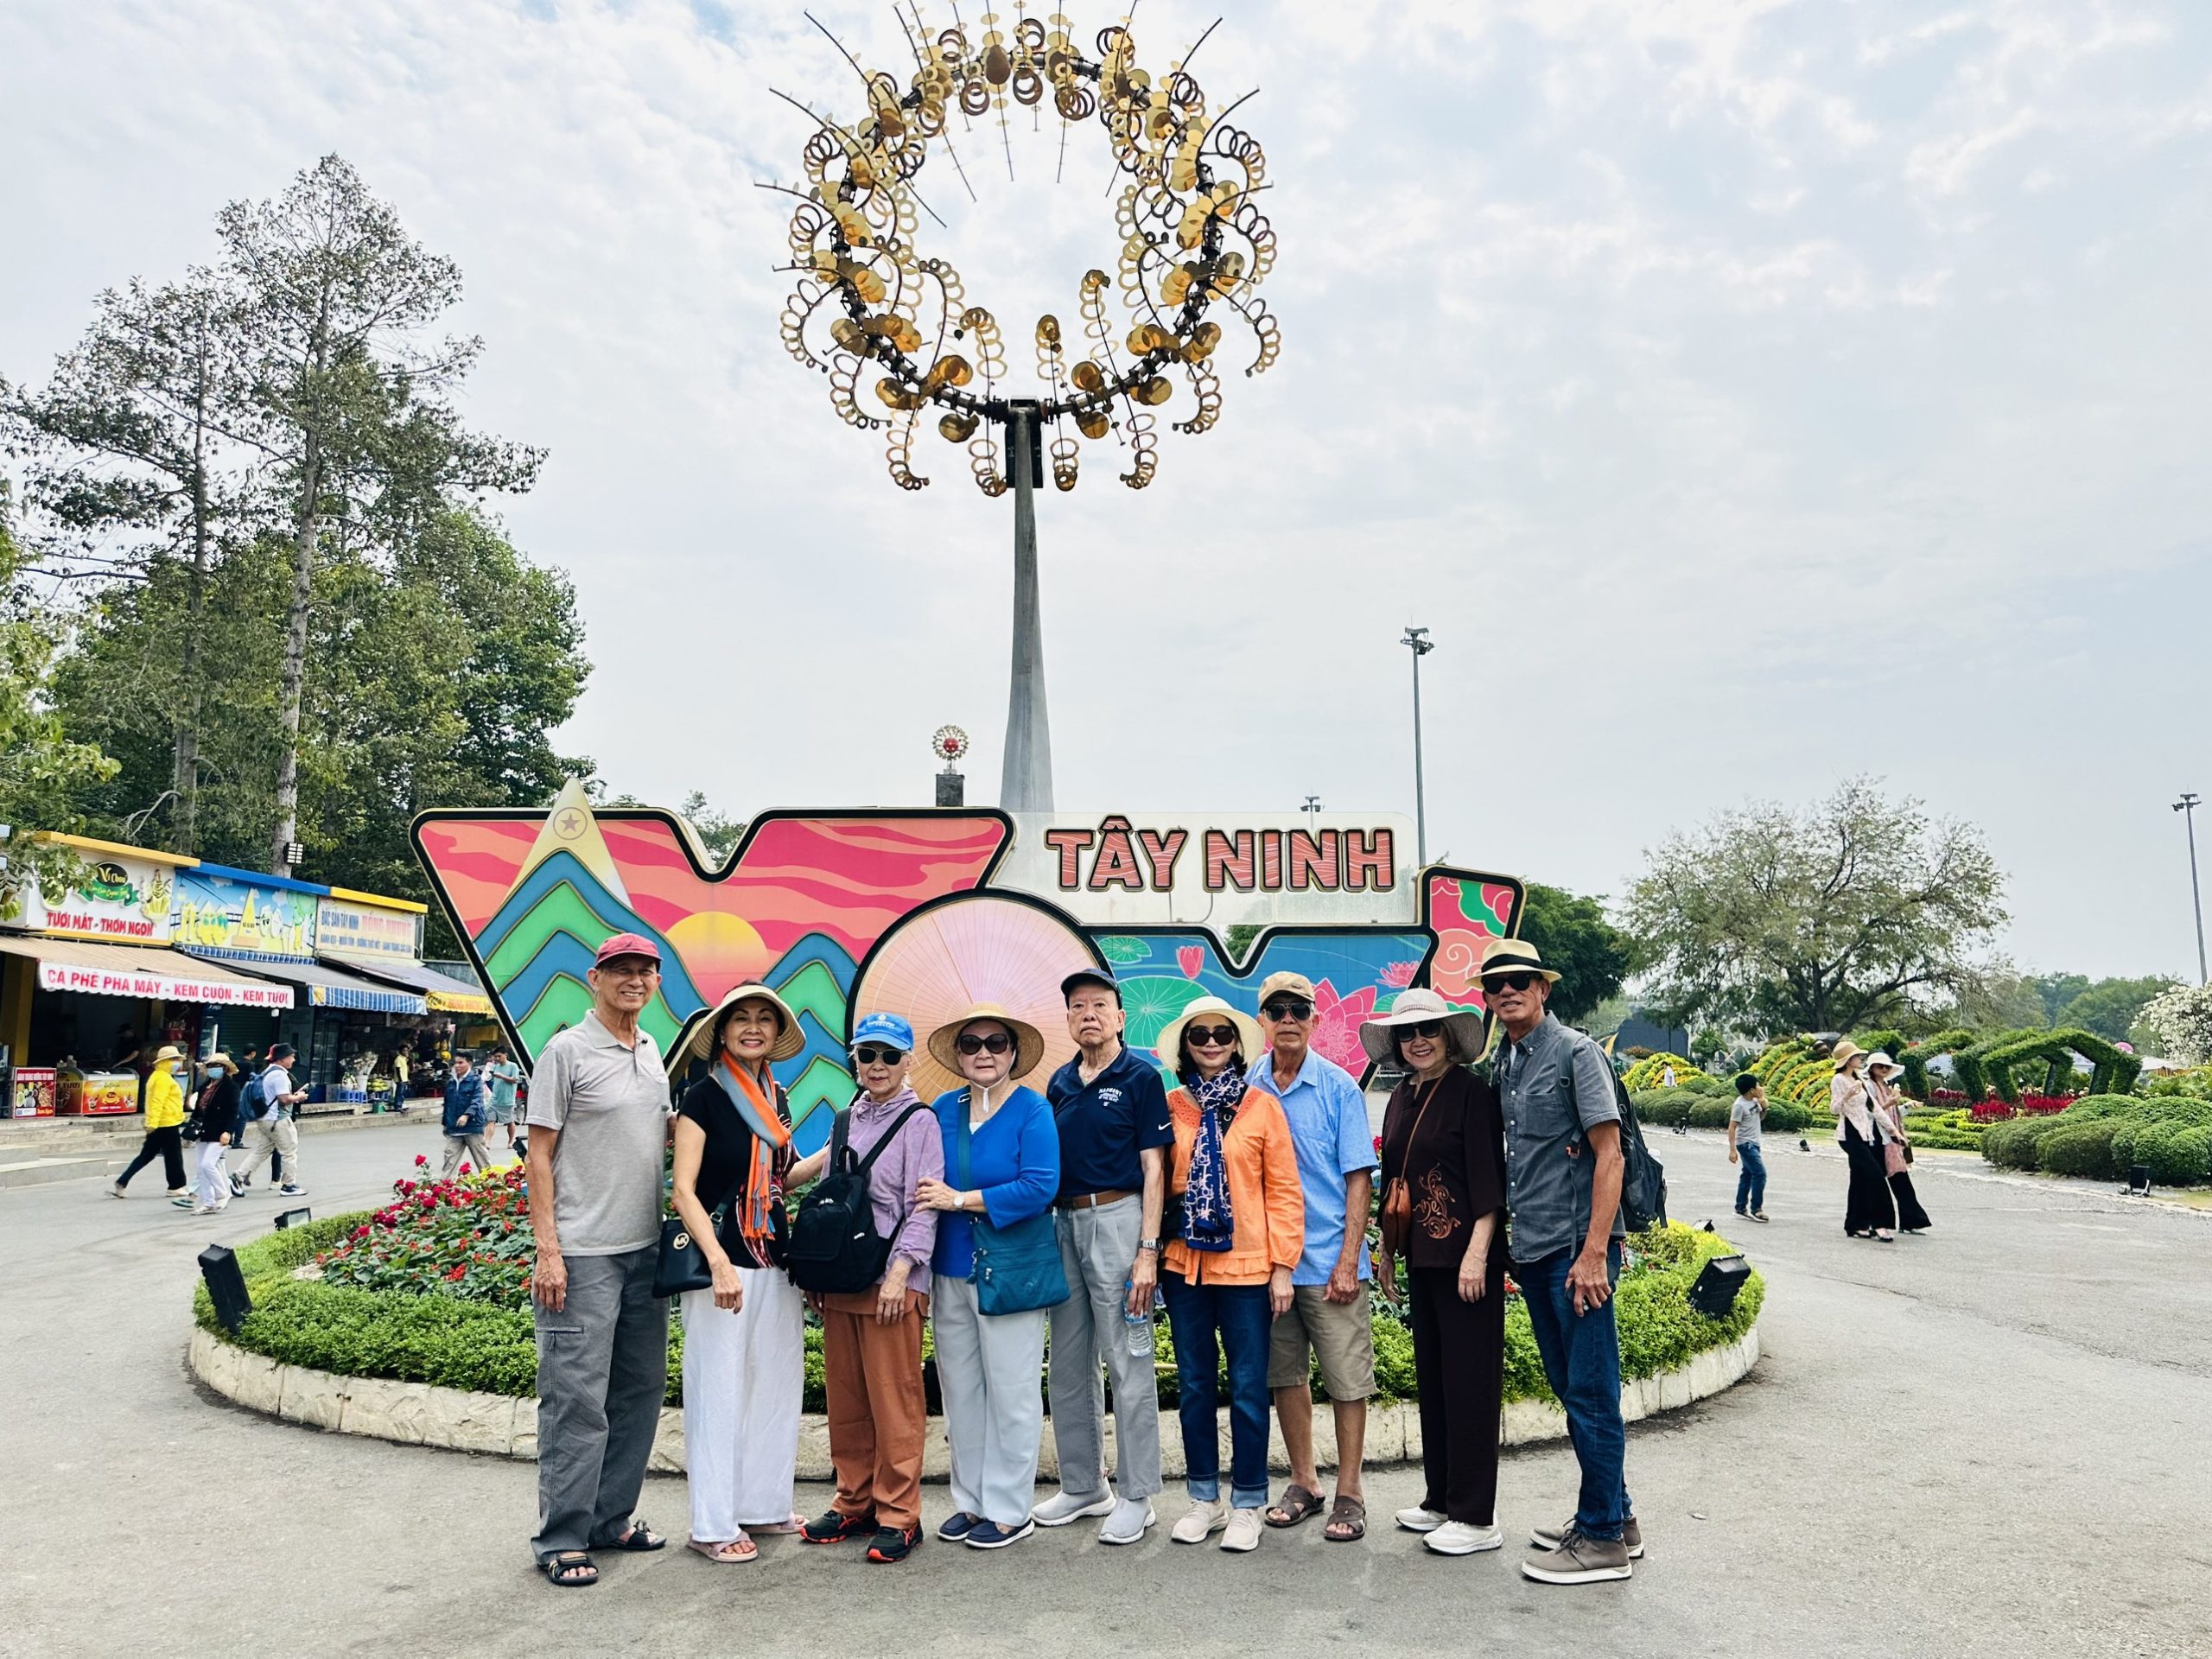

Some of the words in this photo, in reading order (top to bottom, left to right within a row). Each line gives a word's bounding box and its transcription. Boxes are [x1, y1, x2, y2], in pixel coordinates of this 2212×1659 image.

[1044, 814, 1189, 893] TÂY
[1202, 827, 1396, 893] NINH
[72, 912, 93, 931] MÁT
[128, 921, 154, 936] NGON
[71, 971, 100, 988] PHÊ
[104, 976, 130, 992] PHA
[174, 983, 200, 997] KEM
[243, 989, 264, 1002] KEM
